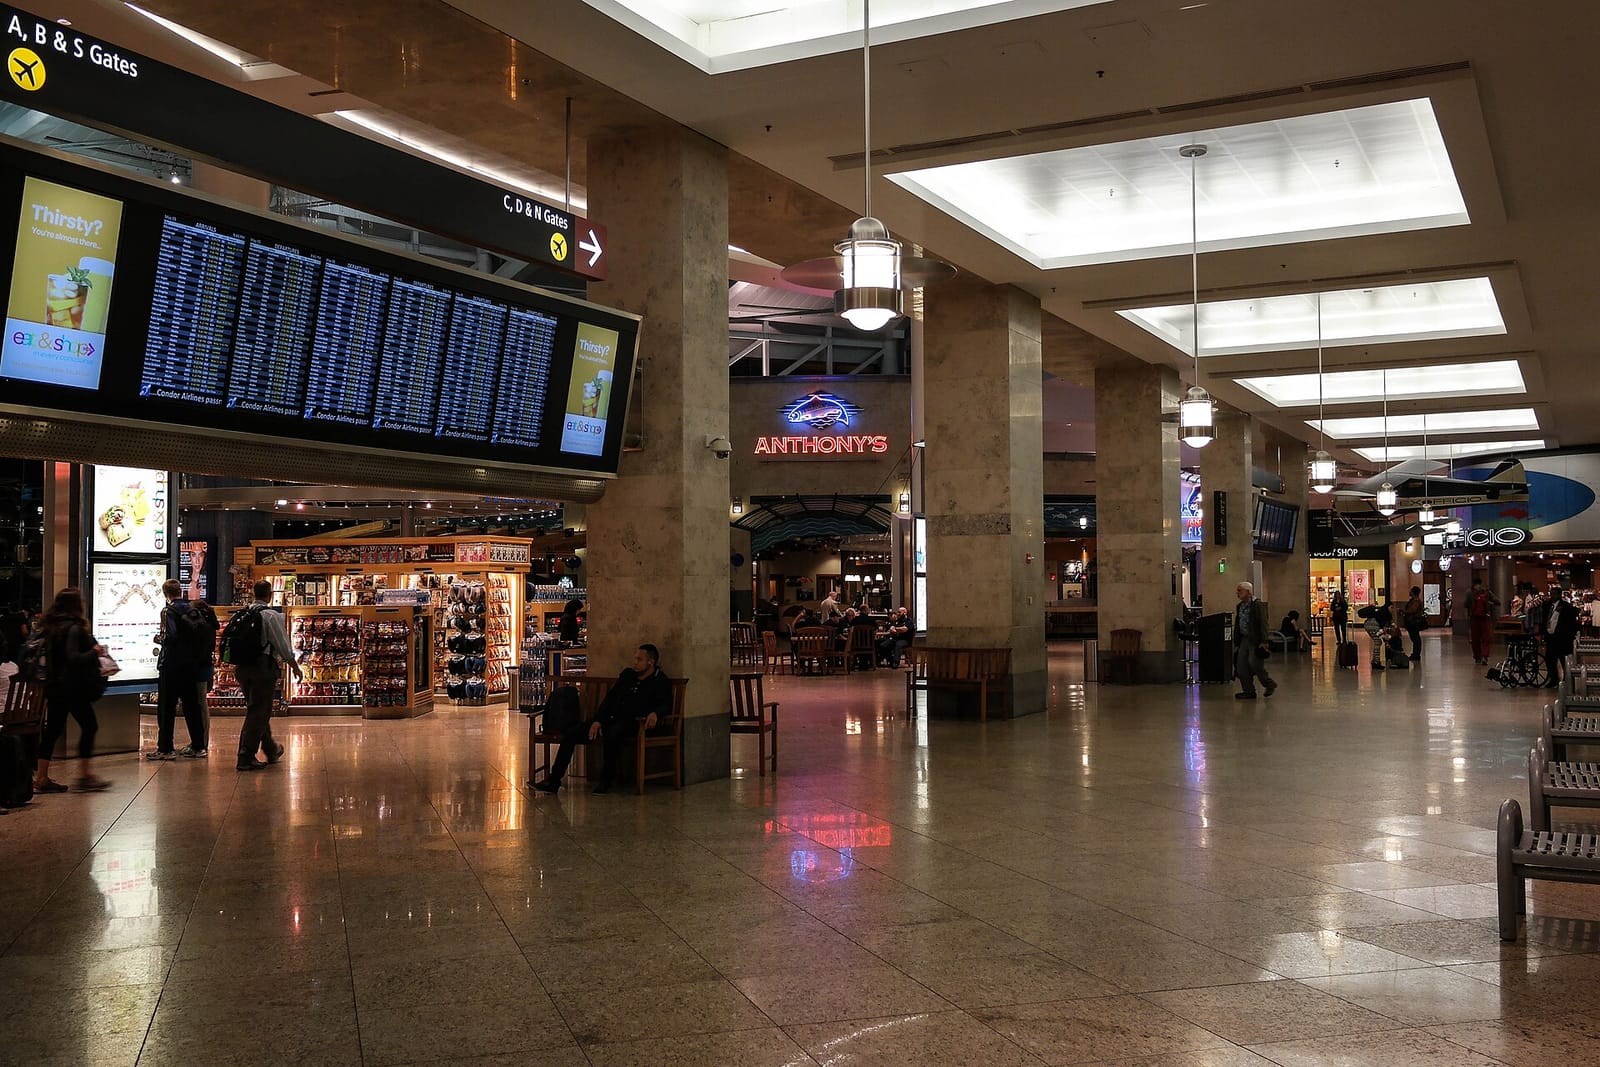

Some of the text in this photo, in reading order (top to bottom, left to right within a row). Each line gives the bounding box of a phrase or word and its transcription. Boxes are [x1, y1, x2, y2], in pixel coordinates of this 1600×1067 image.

[8, 15, 138, 78] A, B & S Gates
[32, 204, 104, 237] Thirsty?
[503, 194, 569, 230] C, D & N Gates
[31, 226, 55, 239] You're
[55, 233, 79, 245] almost
[38, 332, 52, 350] &
[579, 338, 610, 358] Thirsty?
[180, 392, 205, 403] Airlines
[263, 404, 284, 414] Airlines
[754, 435, 888, 454] ANTHONY'S
[1337, 548, 1358, 557] SHOP
